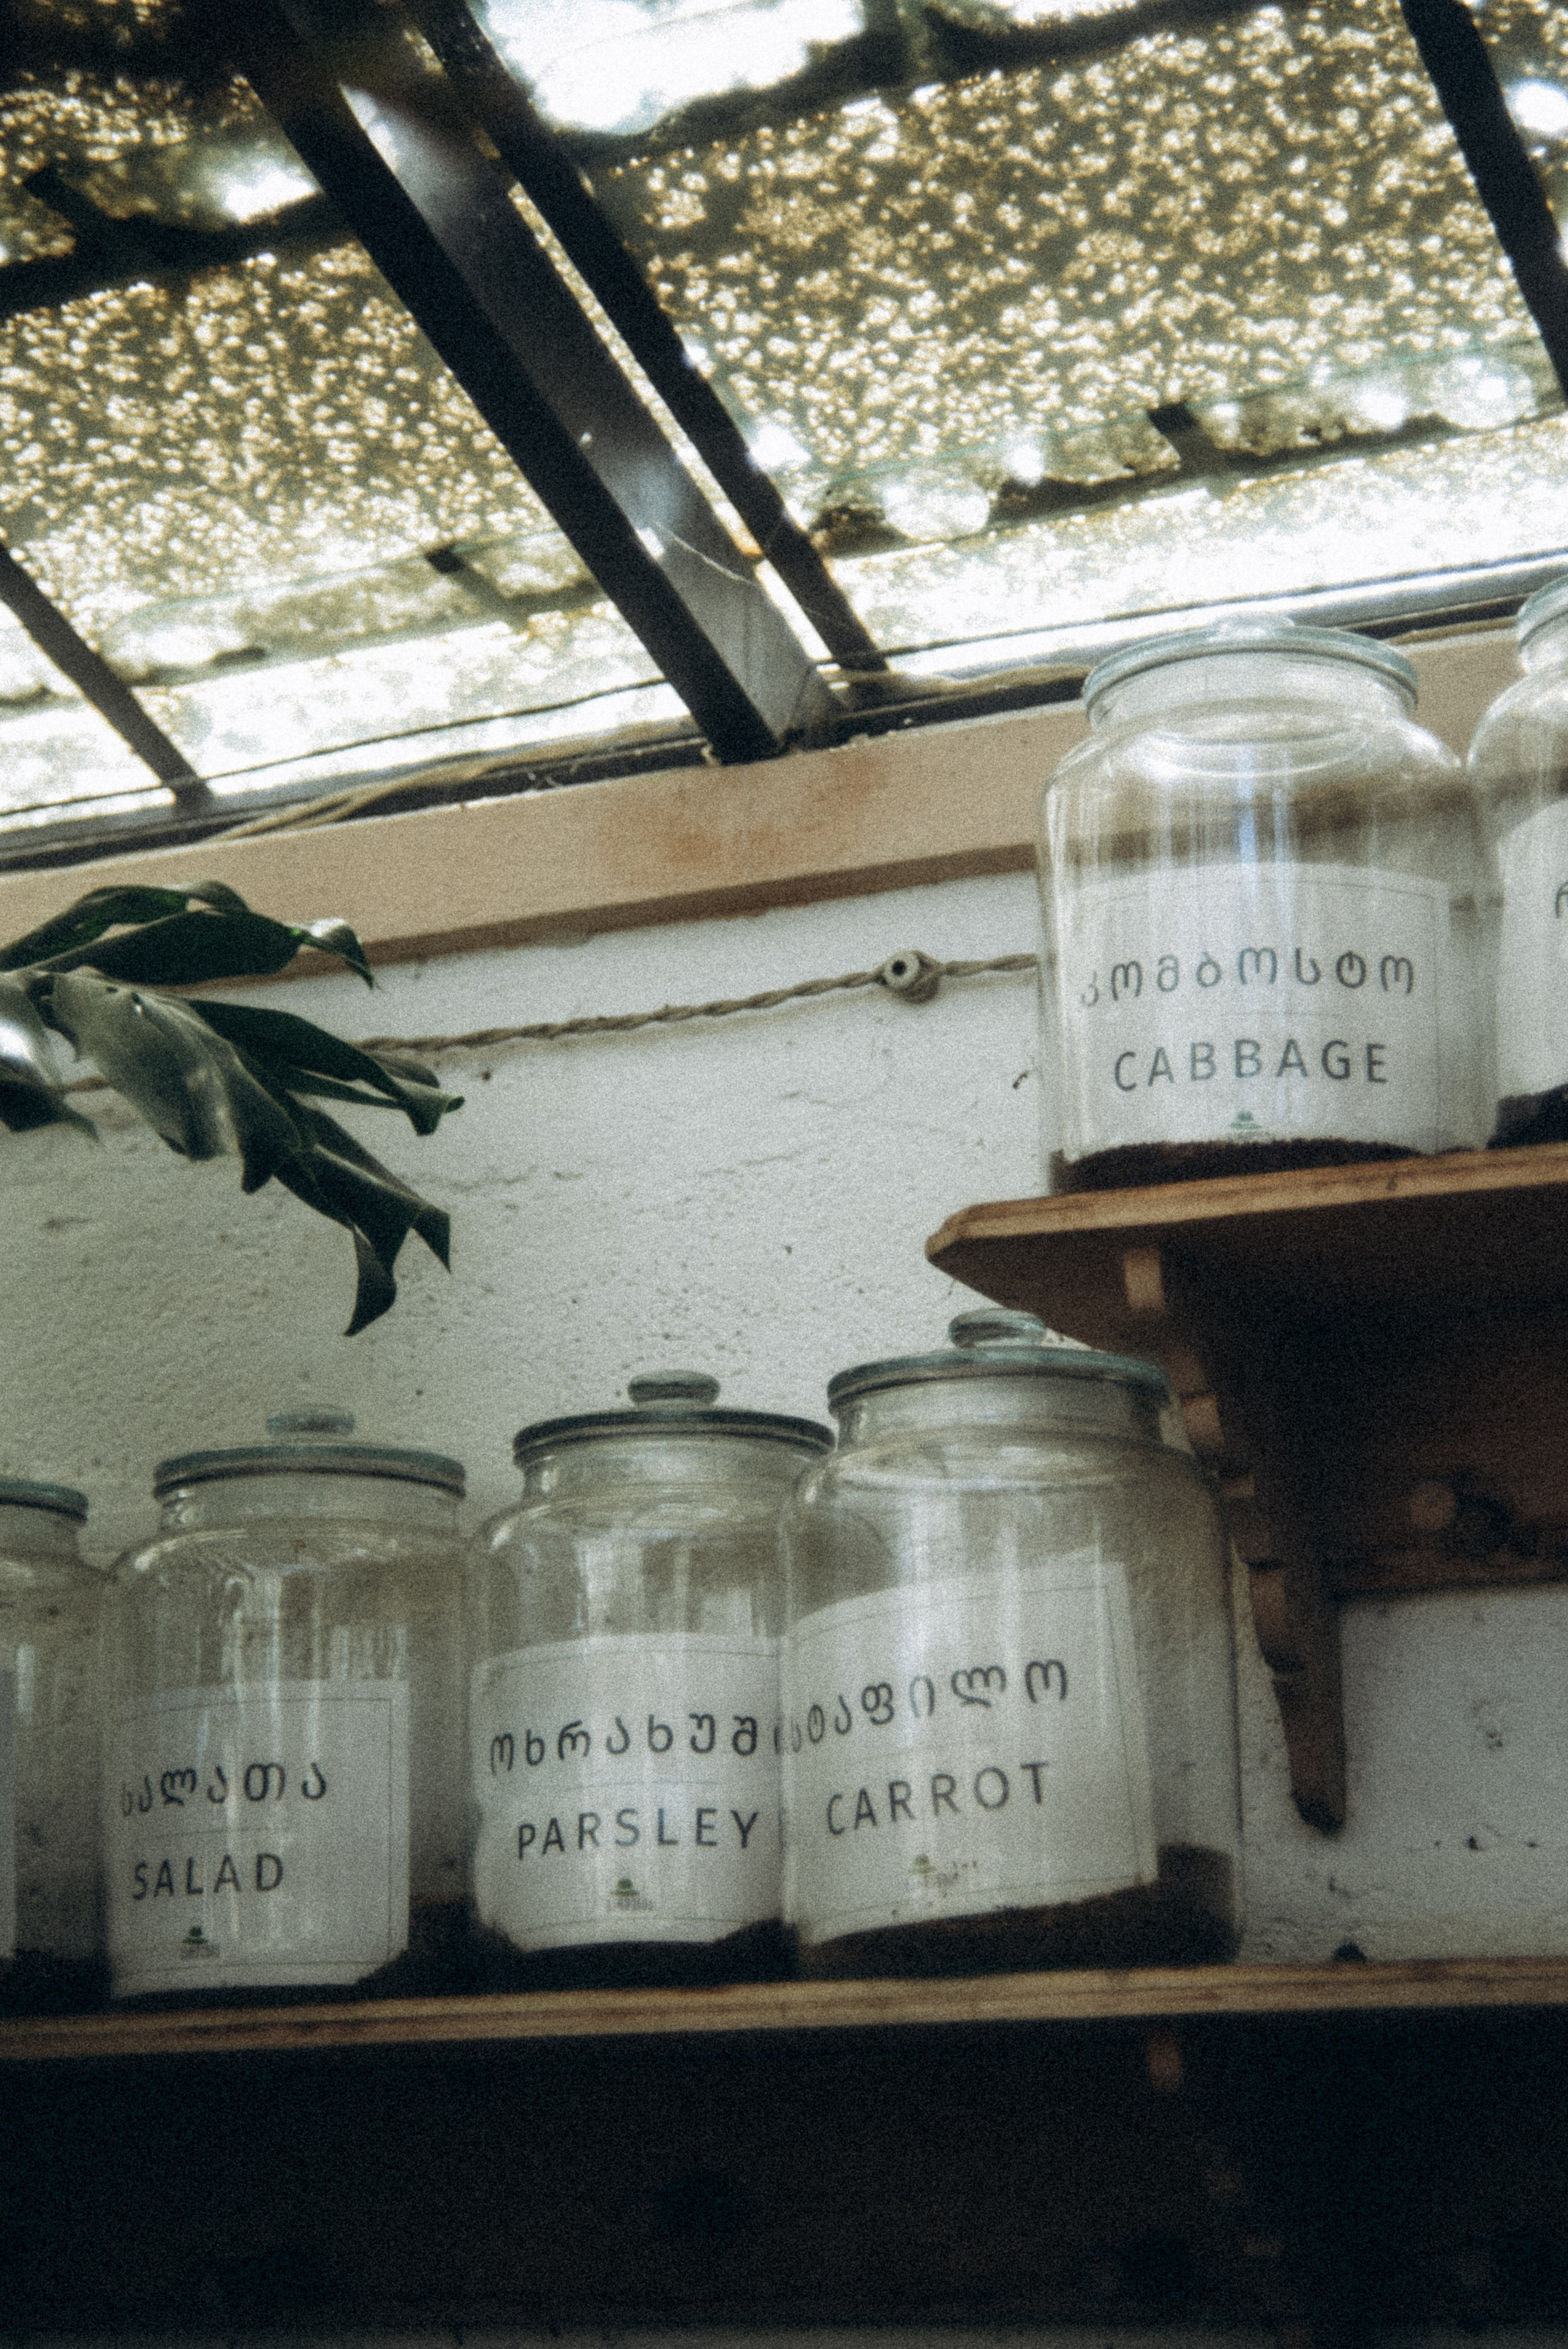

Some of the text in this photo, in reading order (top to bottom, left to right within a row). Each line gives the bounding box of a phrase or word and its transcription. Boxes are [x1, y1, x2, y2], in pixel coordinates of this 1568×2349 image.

[1079, 946, 1415, 1006] კომბოსტო
[1113, 1038, 1388, 1091] CABBAGE
[826, 1760, 1050, 1836] CARROT
[517, 1807, 759, 1861] PARSLEY
[131, 1852, 284, 1901] SALAD
